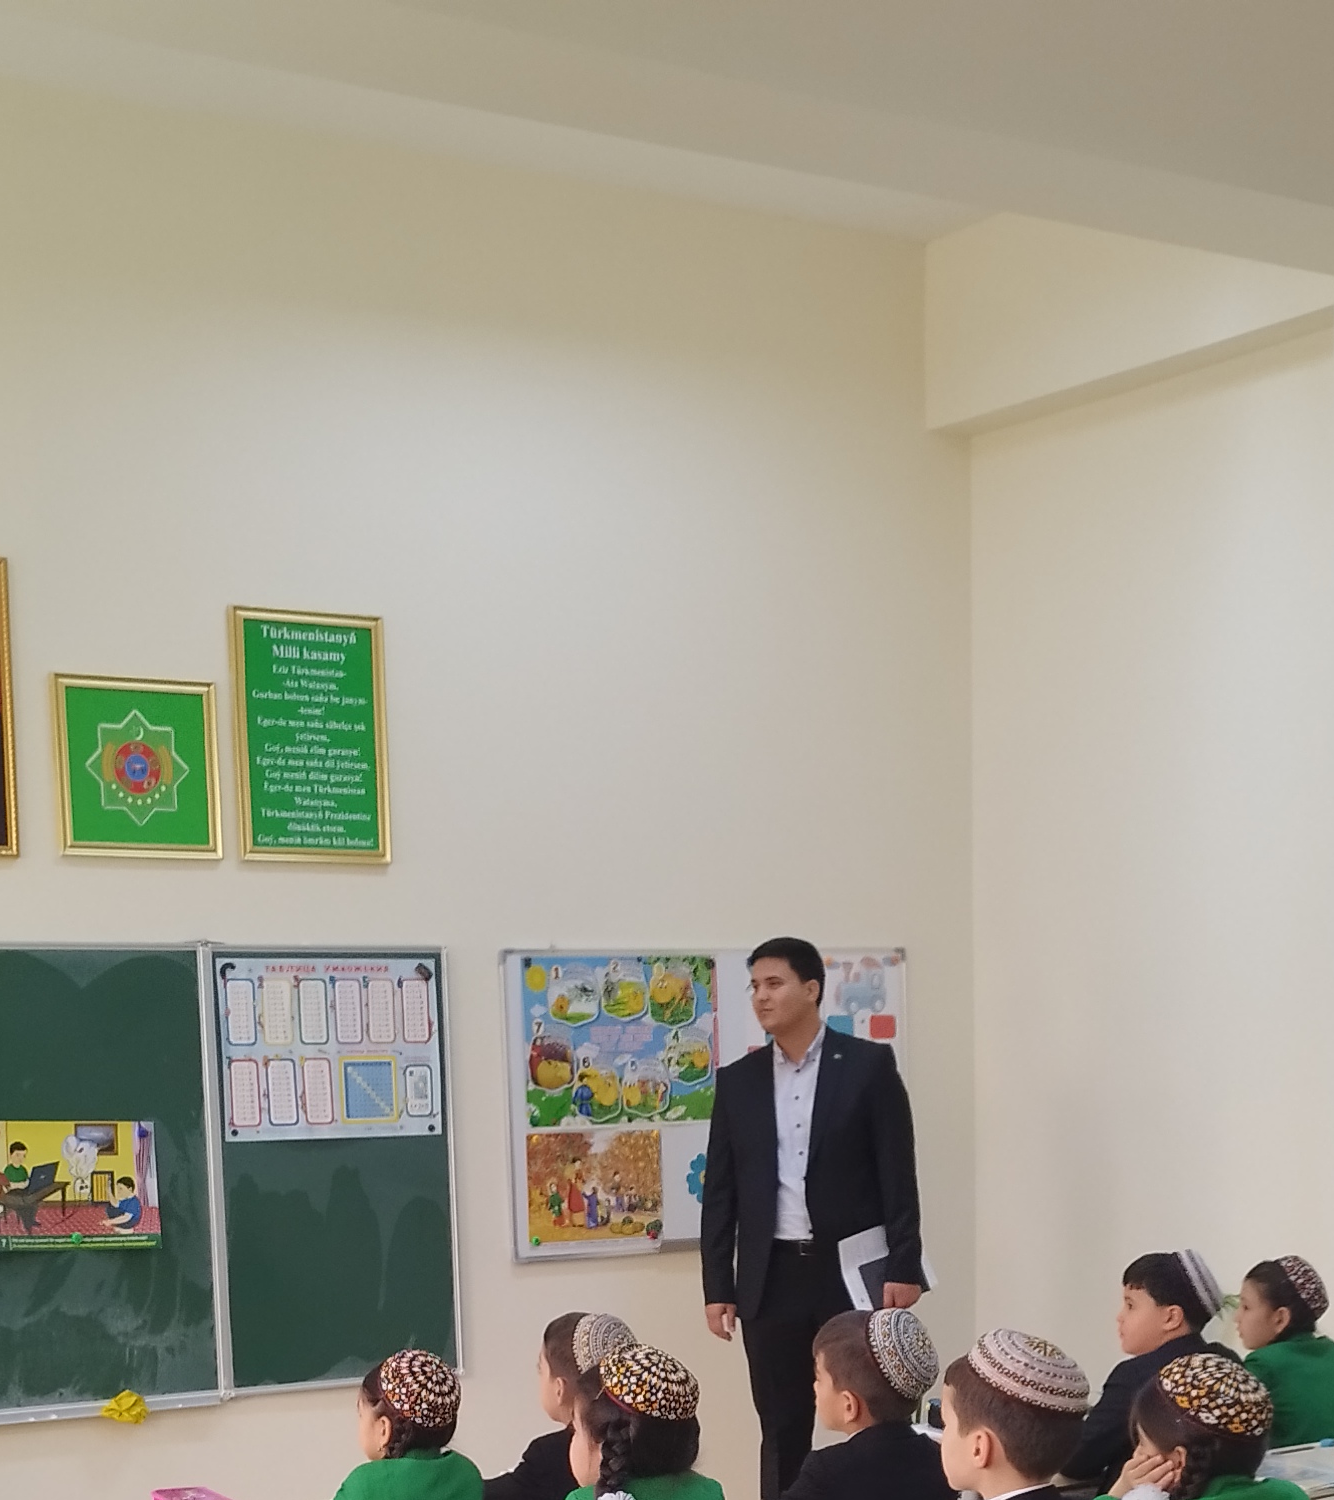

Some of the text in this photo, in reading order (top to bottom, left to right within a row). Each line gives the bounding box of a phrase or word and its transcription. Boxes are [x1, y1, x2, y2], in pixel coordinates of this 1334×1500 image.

[260, 624, 357, 647] Türkmenistanyň
[272, 643, 346, 665] Milli kasamy
